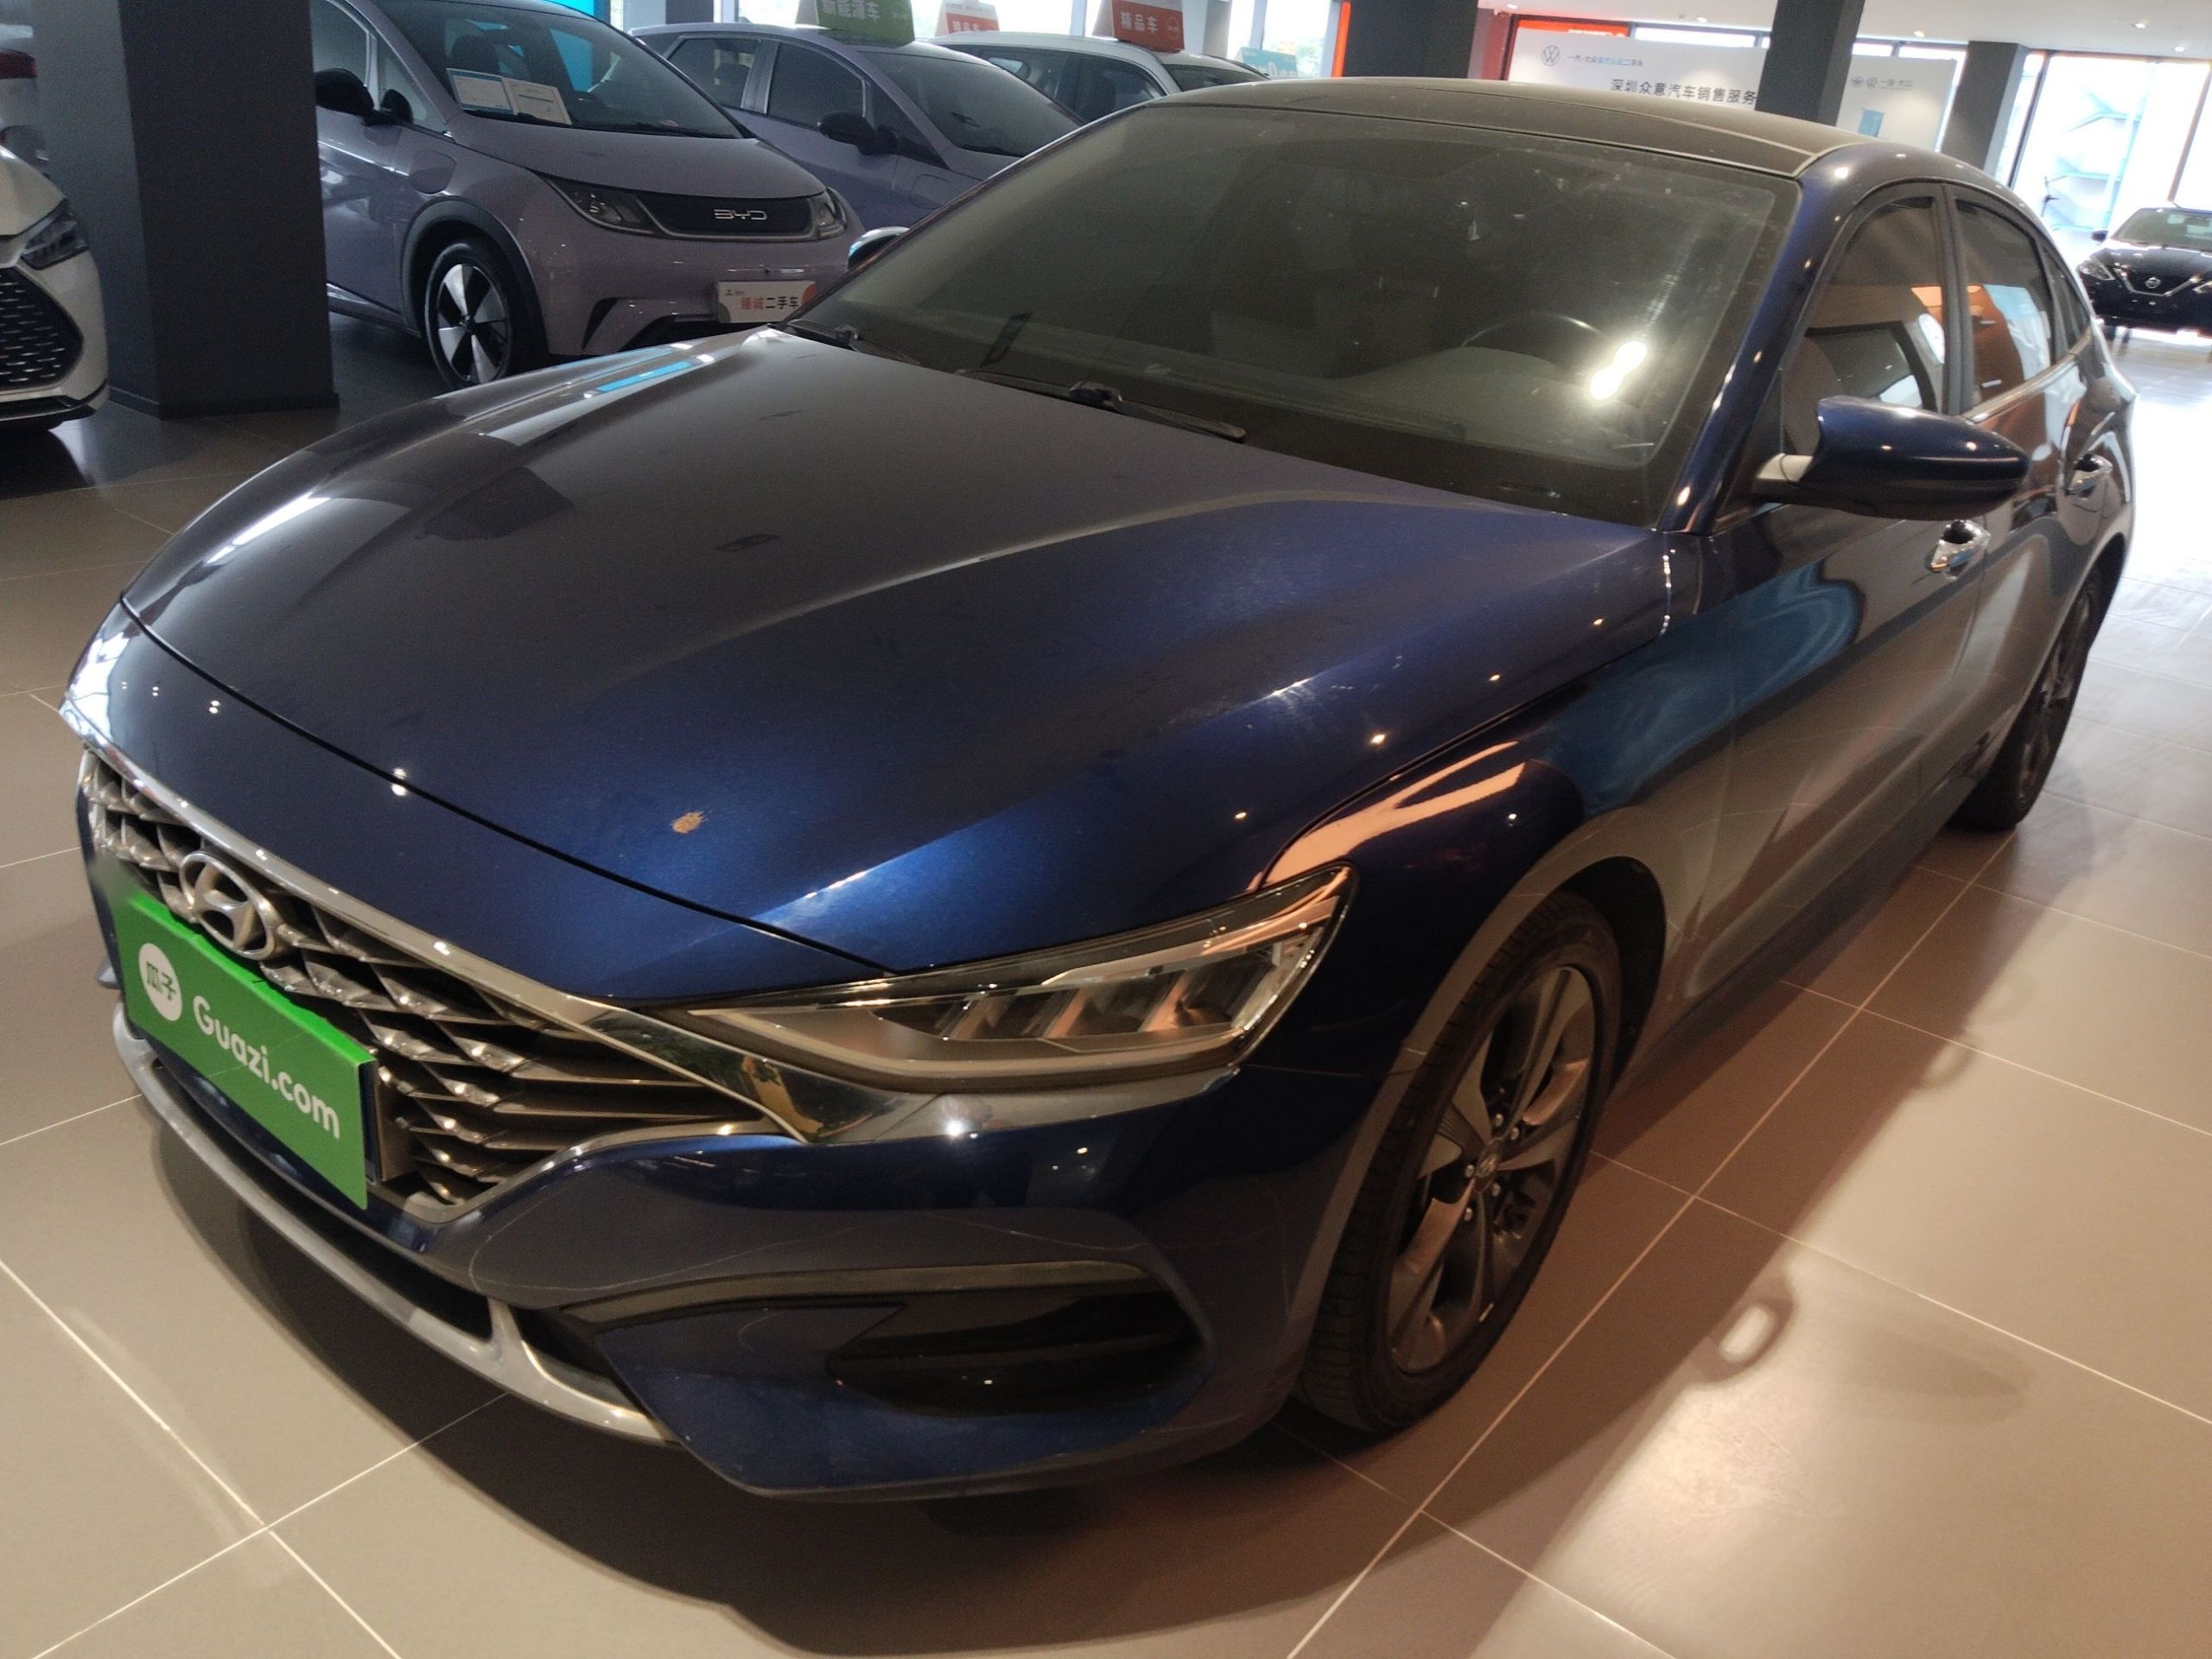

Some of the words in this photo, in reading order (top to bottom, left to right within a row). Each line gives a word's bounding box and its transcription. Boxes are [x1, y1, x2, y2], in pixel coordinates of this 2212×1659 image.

[1120, 10, 1158, 34] 精品车
[714, 208, 768, 220] BYD
[193, 995, 340, 1139] Guazi.com
